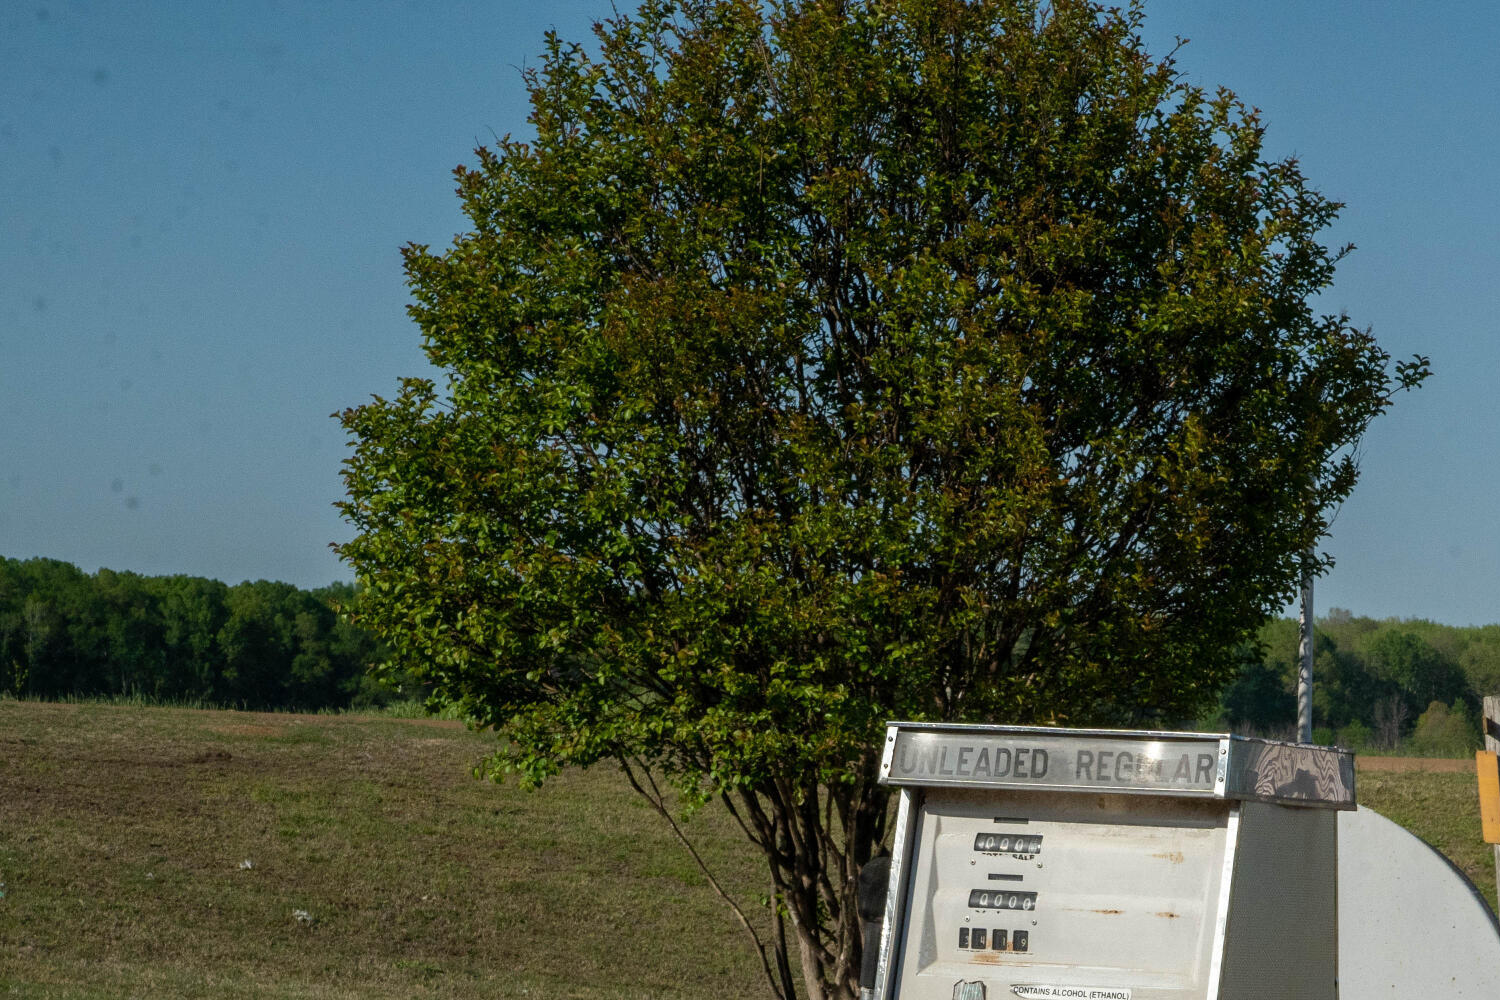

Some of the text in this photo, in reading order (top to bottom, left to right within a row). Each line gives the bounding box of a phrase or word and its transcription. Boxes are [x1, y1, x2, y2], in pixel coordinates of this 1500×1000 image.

[901, 744, 1049, 779] UNLEADED
[1013, 986, 1130, 1000] CONTAINS ALCOHOL (ETHANOL)
